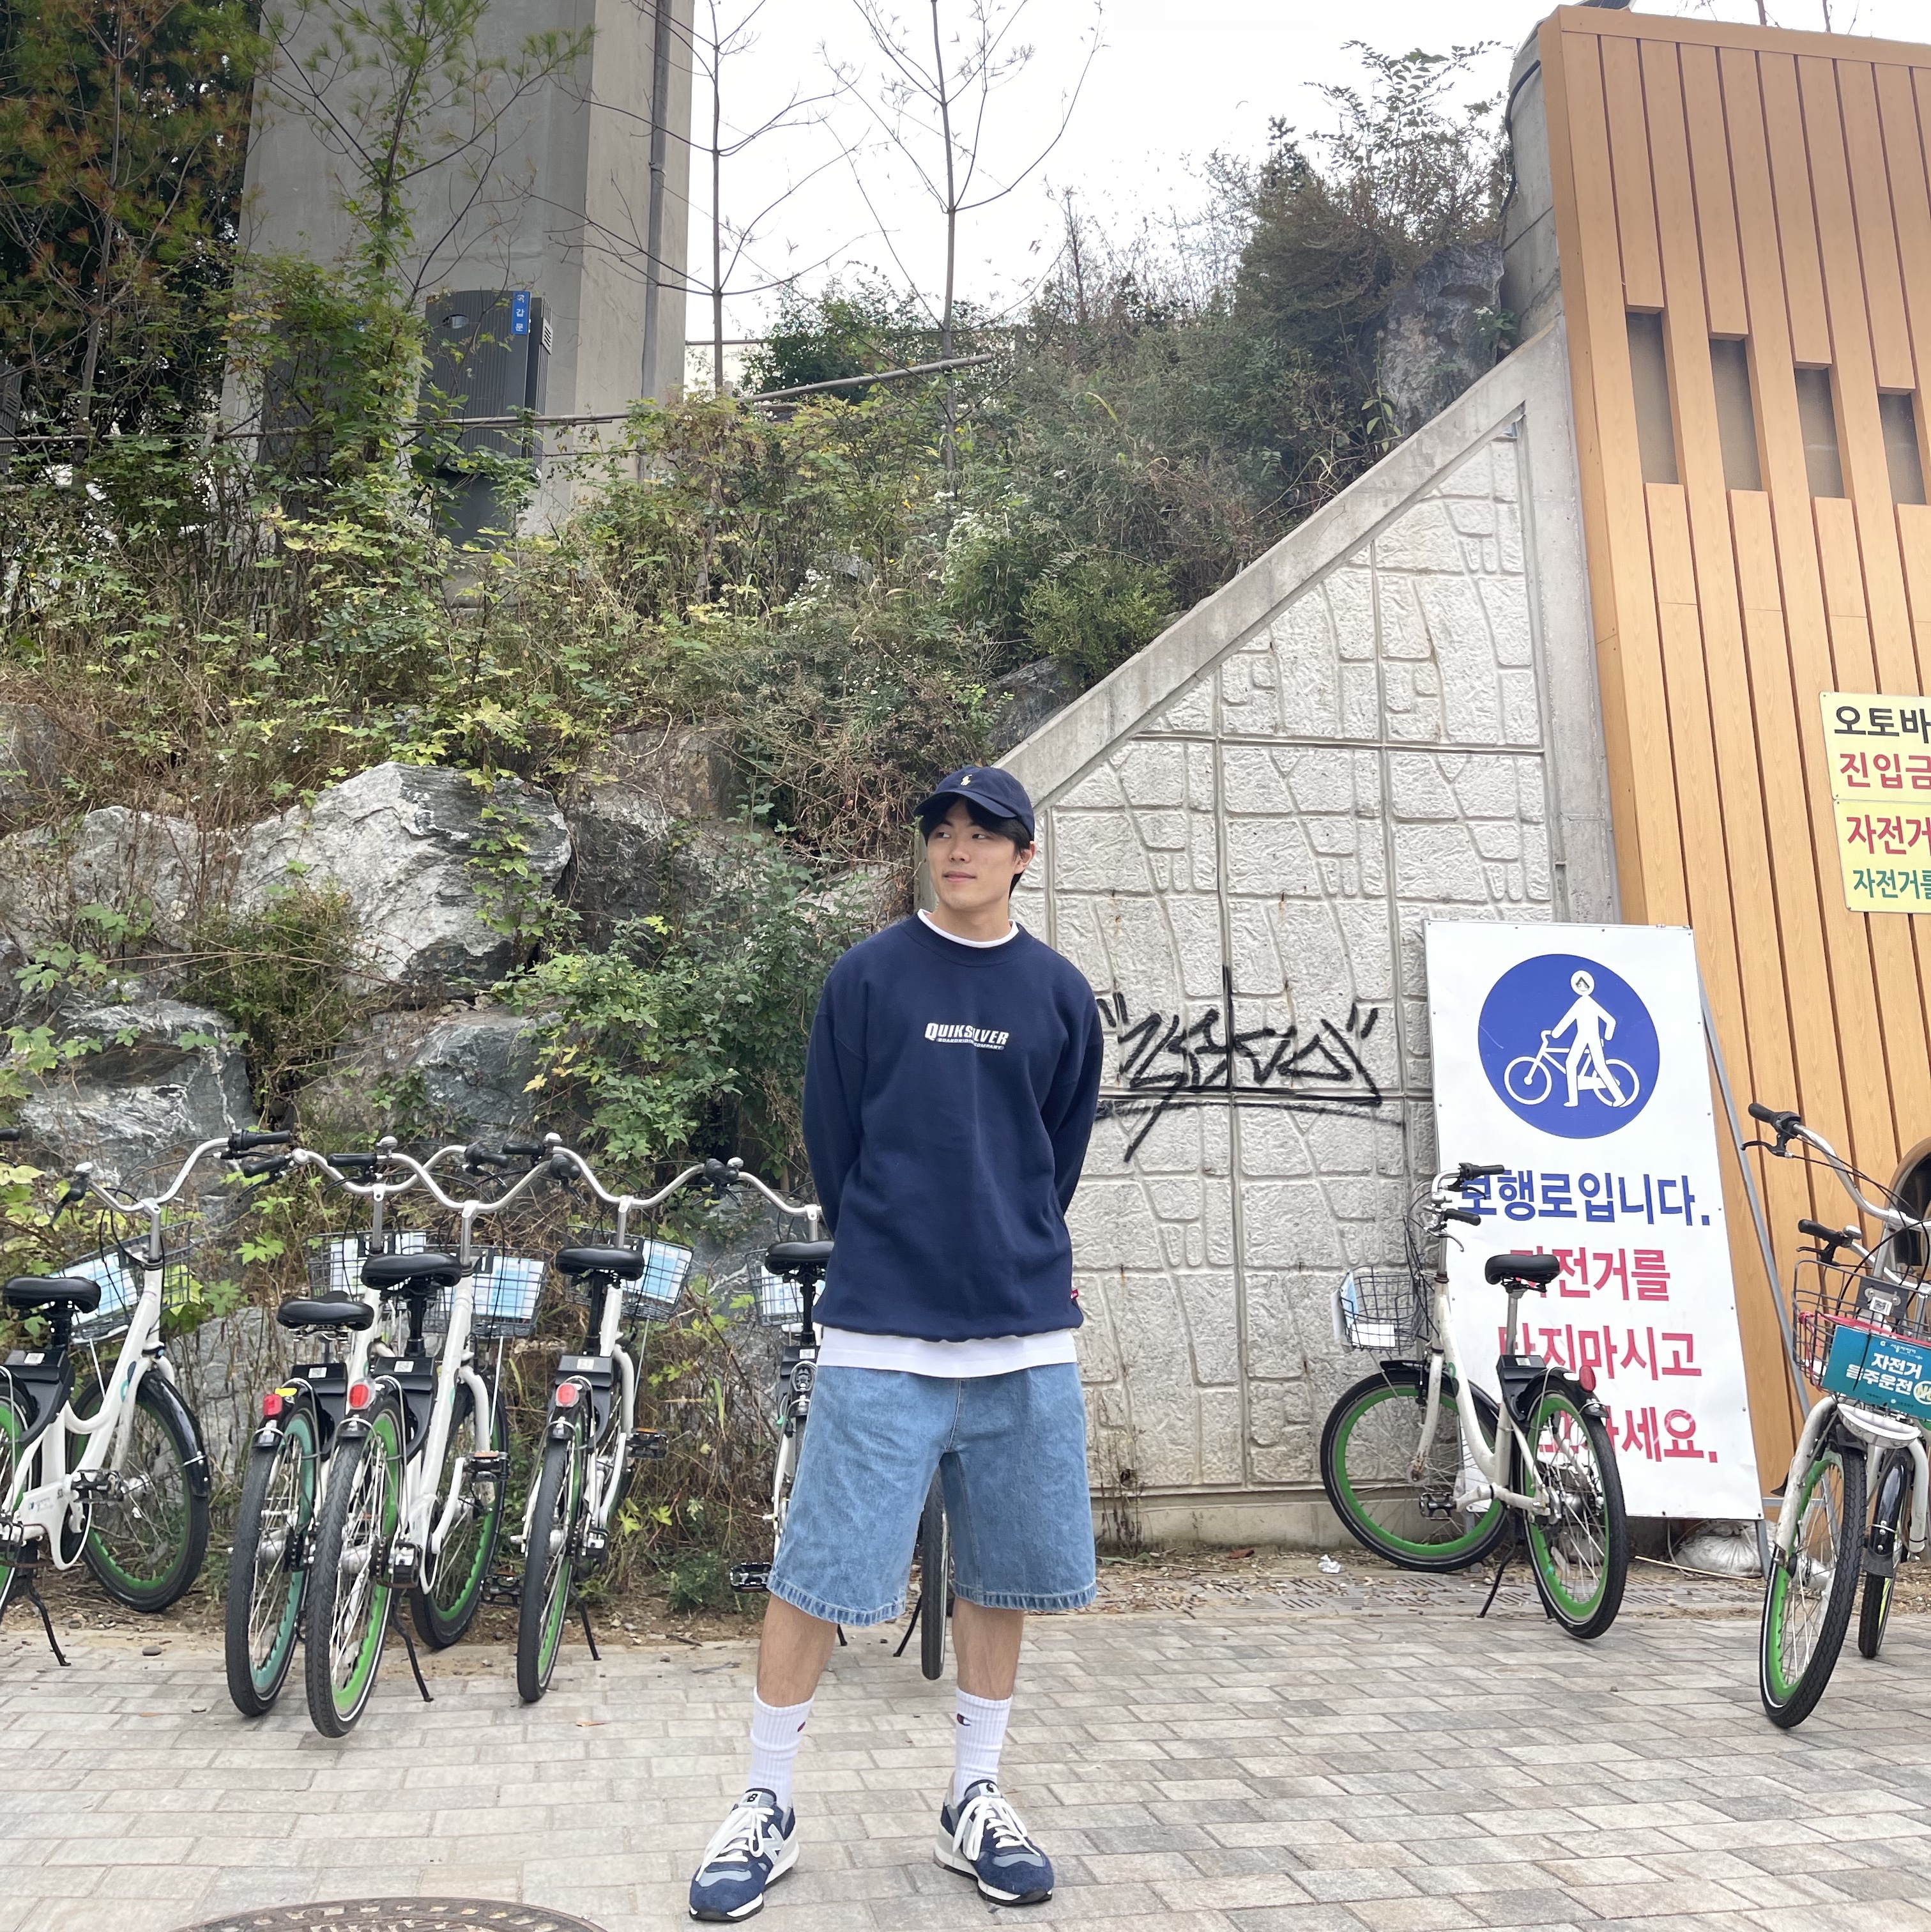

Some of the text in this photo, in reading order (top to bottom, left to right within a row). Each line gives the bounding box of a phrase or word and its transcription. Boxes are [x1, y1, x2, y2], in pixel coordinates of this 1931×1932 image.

[924, 1022, 1009, 1045] QUIKSILVER
[1458, 1169, 1710, 1225] 보행로입니다.
[1510, 1246, 1671, 1301] 전거를
[1846, 1363, 1913, 1396] 음주운전
[1871, 1353, 1923, 1379] 자전거
